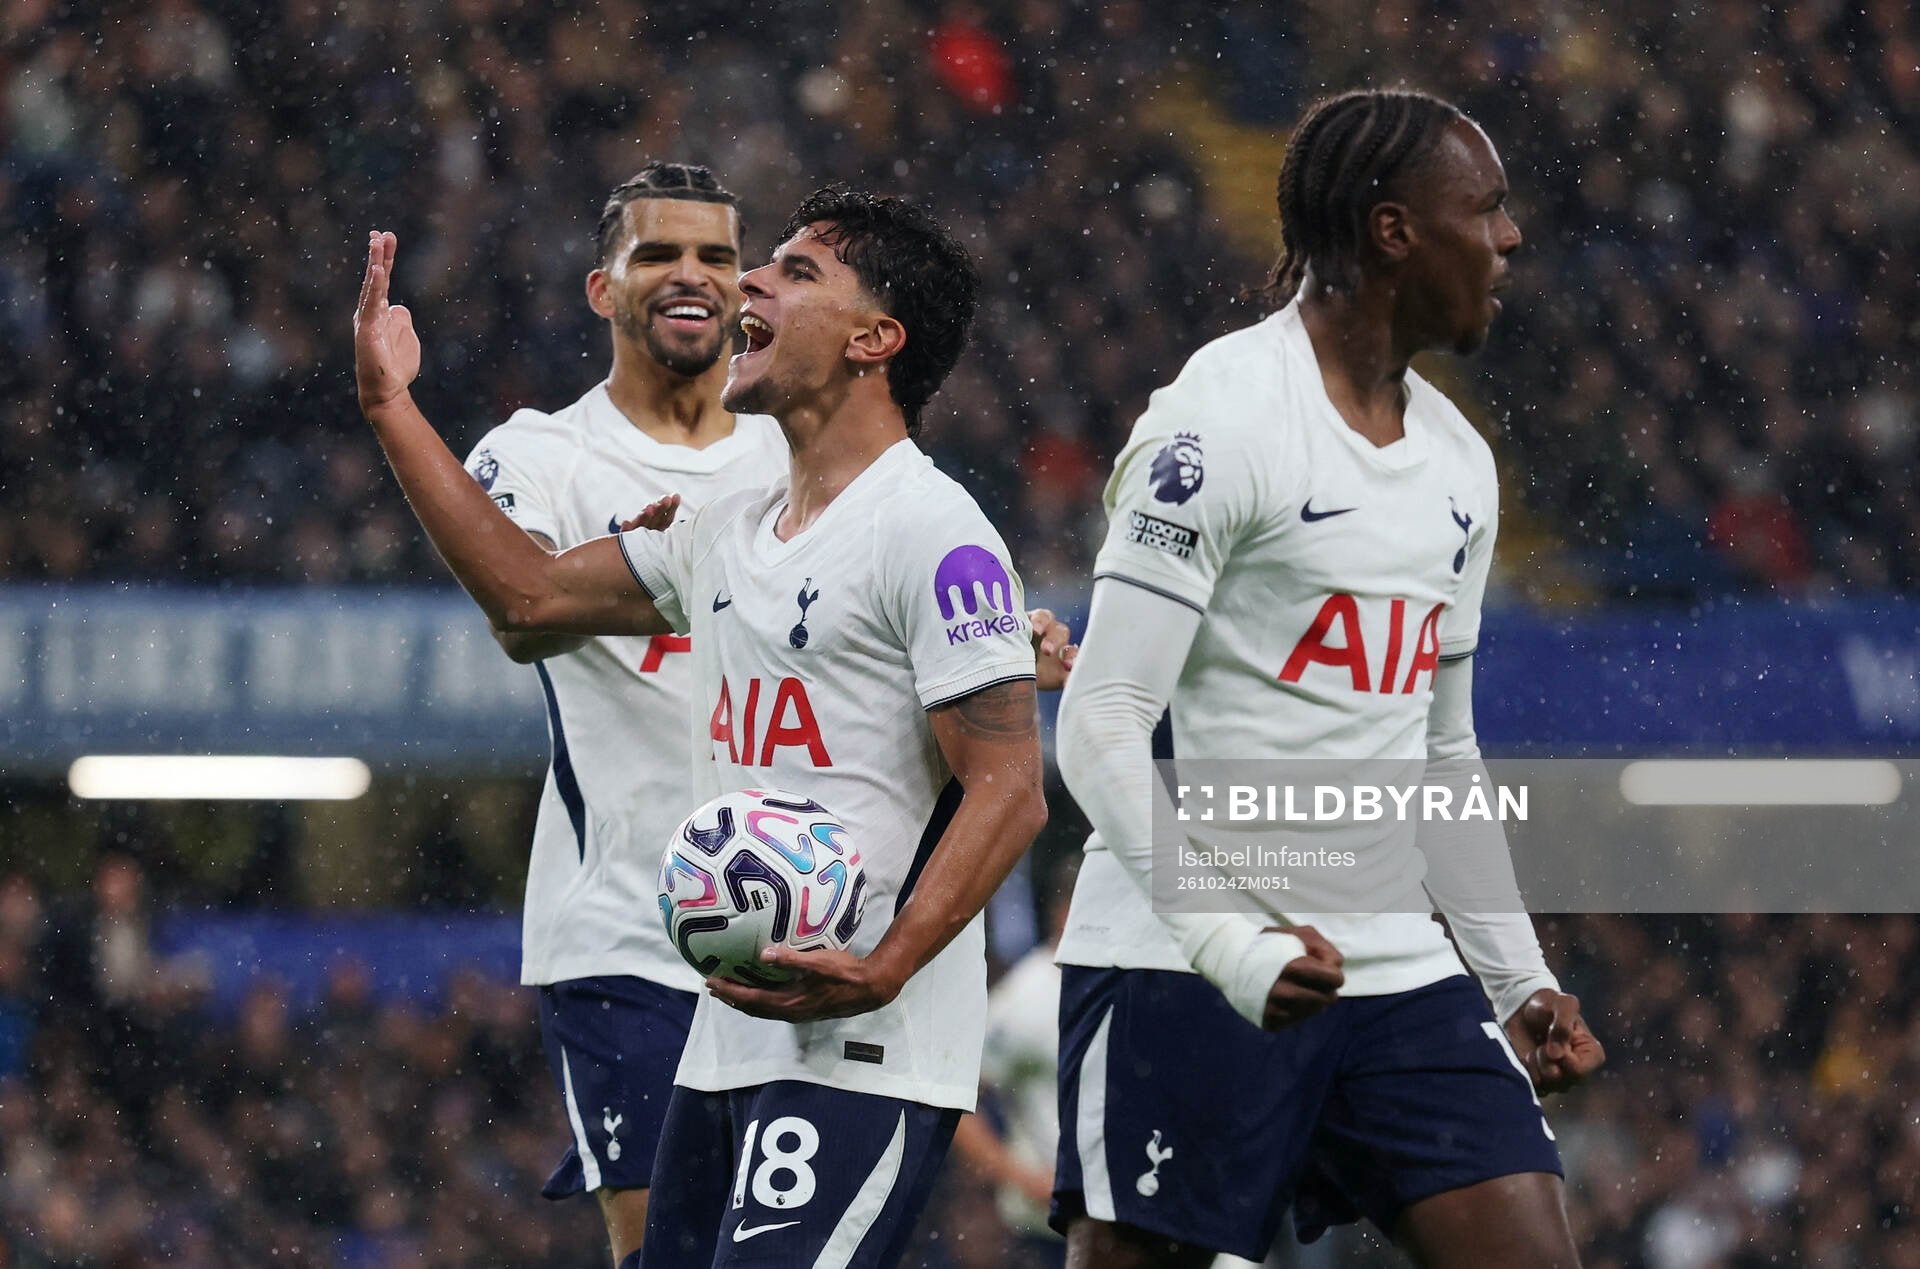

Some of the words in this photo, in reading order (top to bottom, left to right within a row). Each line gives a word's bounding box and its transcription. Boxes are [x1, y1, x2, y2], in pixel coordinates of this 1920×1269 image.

[1278, 592, 1446, 694] AIA
[710, 673, 834, 768] AIA
[732, 1116, 820, 1210] 18
